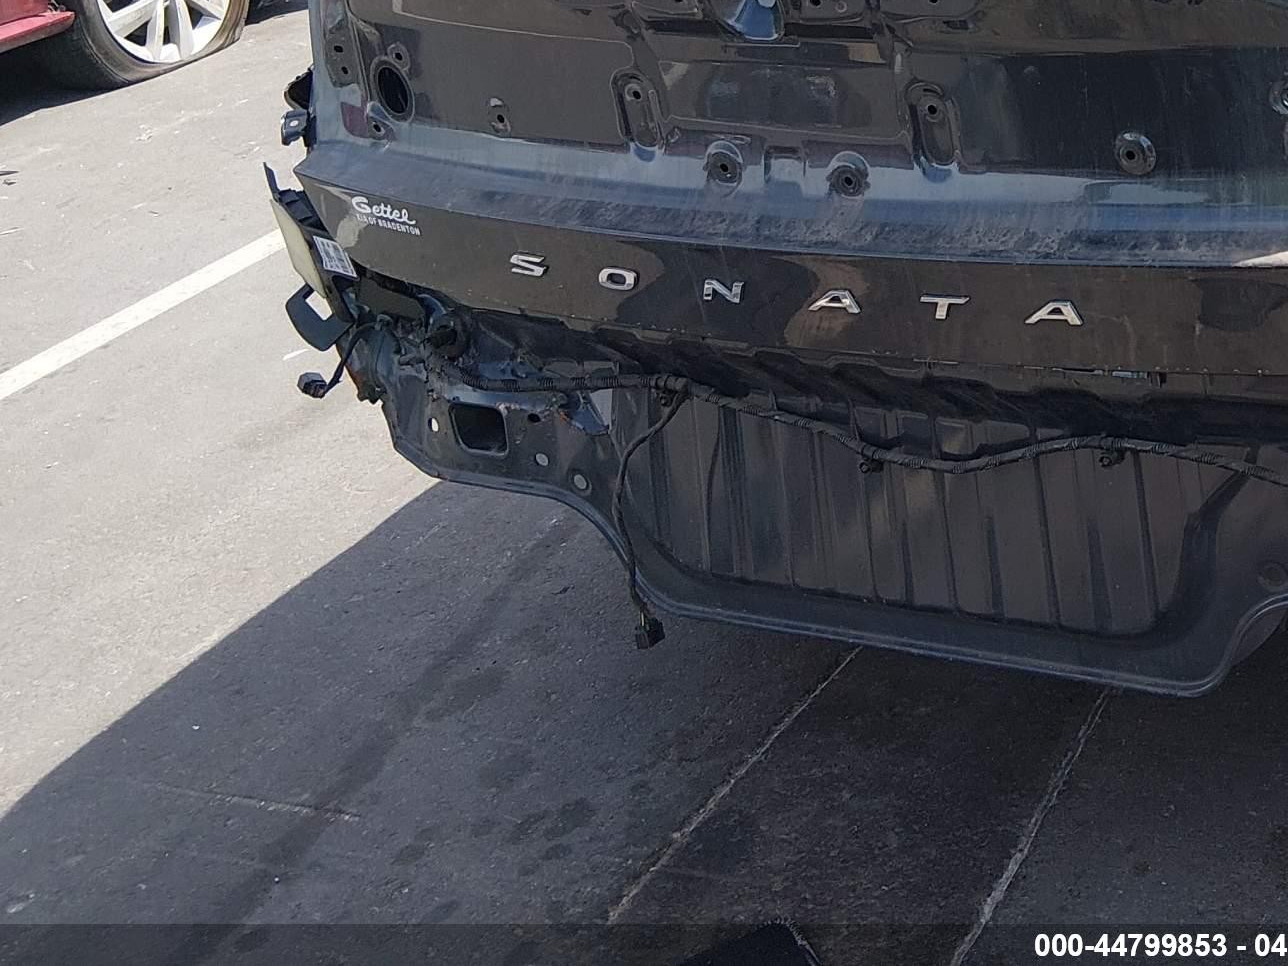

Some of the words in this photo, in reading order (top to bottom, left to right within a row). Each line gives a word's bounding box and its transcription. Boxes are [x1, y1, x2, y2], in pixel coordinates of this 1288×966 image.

[351, 196, 417, 224] Gettel
[377, 219, 421, 236] BRADENTON
[509, 251, 1085, 327] SONATA
